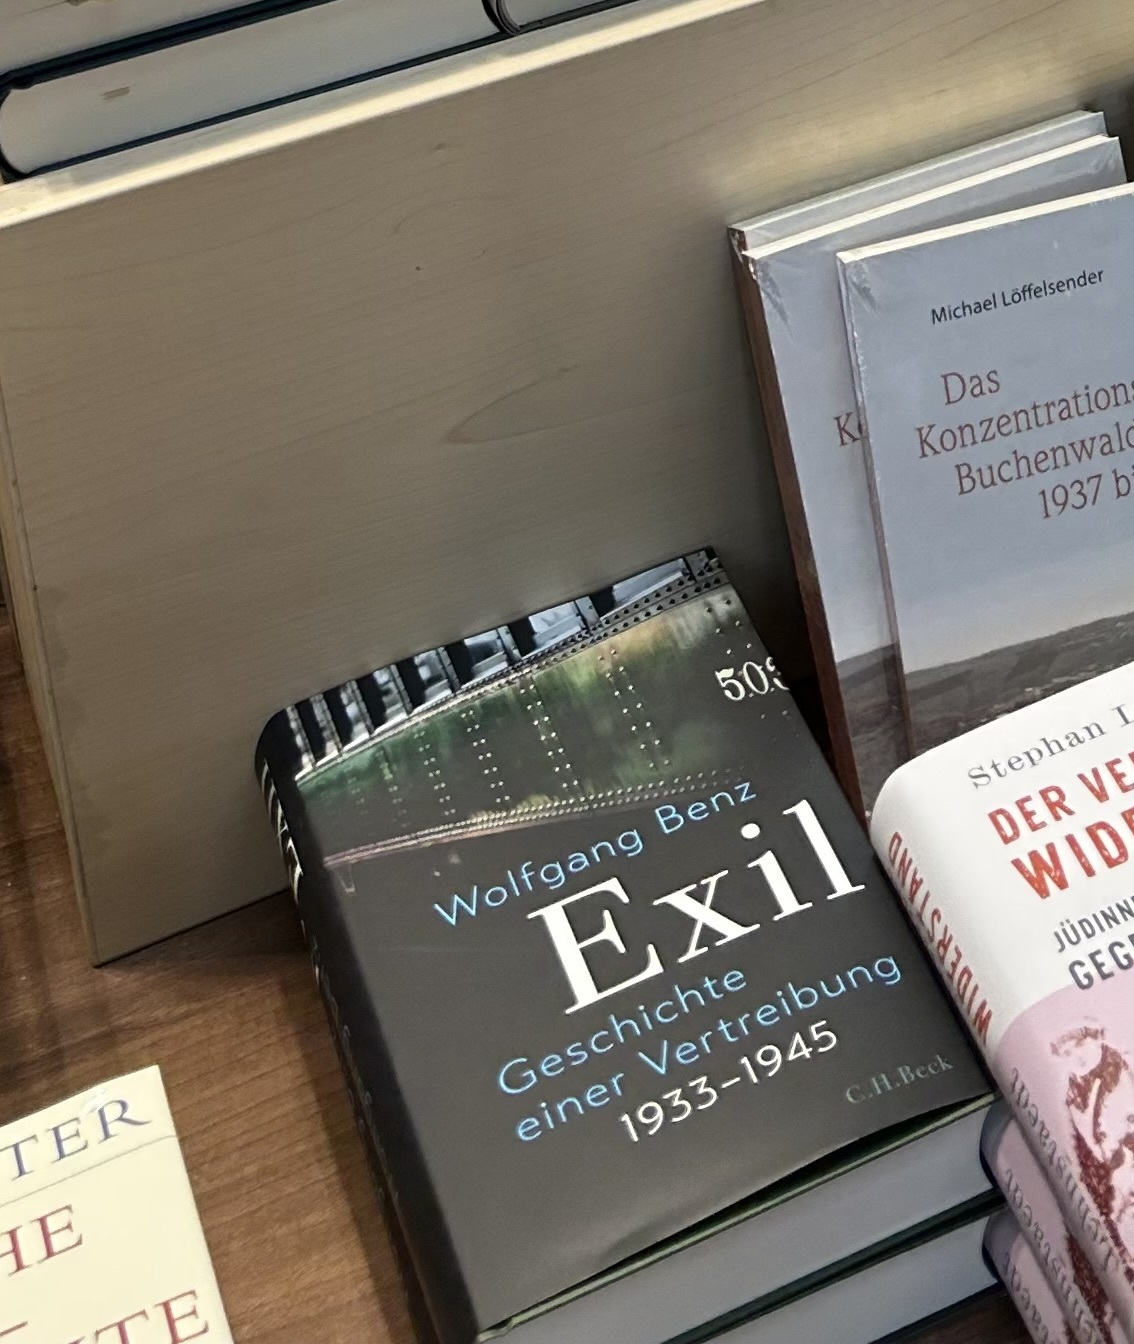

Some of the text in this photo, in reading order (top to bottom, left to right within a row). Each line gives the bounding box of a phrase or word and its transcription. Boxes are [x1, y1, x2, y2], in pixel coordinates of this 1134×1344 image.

[931, 267, 1106, 325] Michael Löffelsender
[940, 366, 1001, 407] Das
[1038, 474, 1104, 519] 1937
[967, 718, 1109, 793] Stephan
[987, 782, 1077, 846] DER
[433, 778, 759, 930] Wolfgang Benz
[525, 797, 868, 1017] Exil
[496, 962, 751, 1099] Geschichte
[514, 951, 906, 1145] einer Vertreibung
[844, 1051, 956, 1108] C.H.Beck
